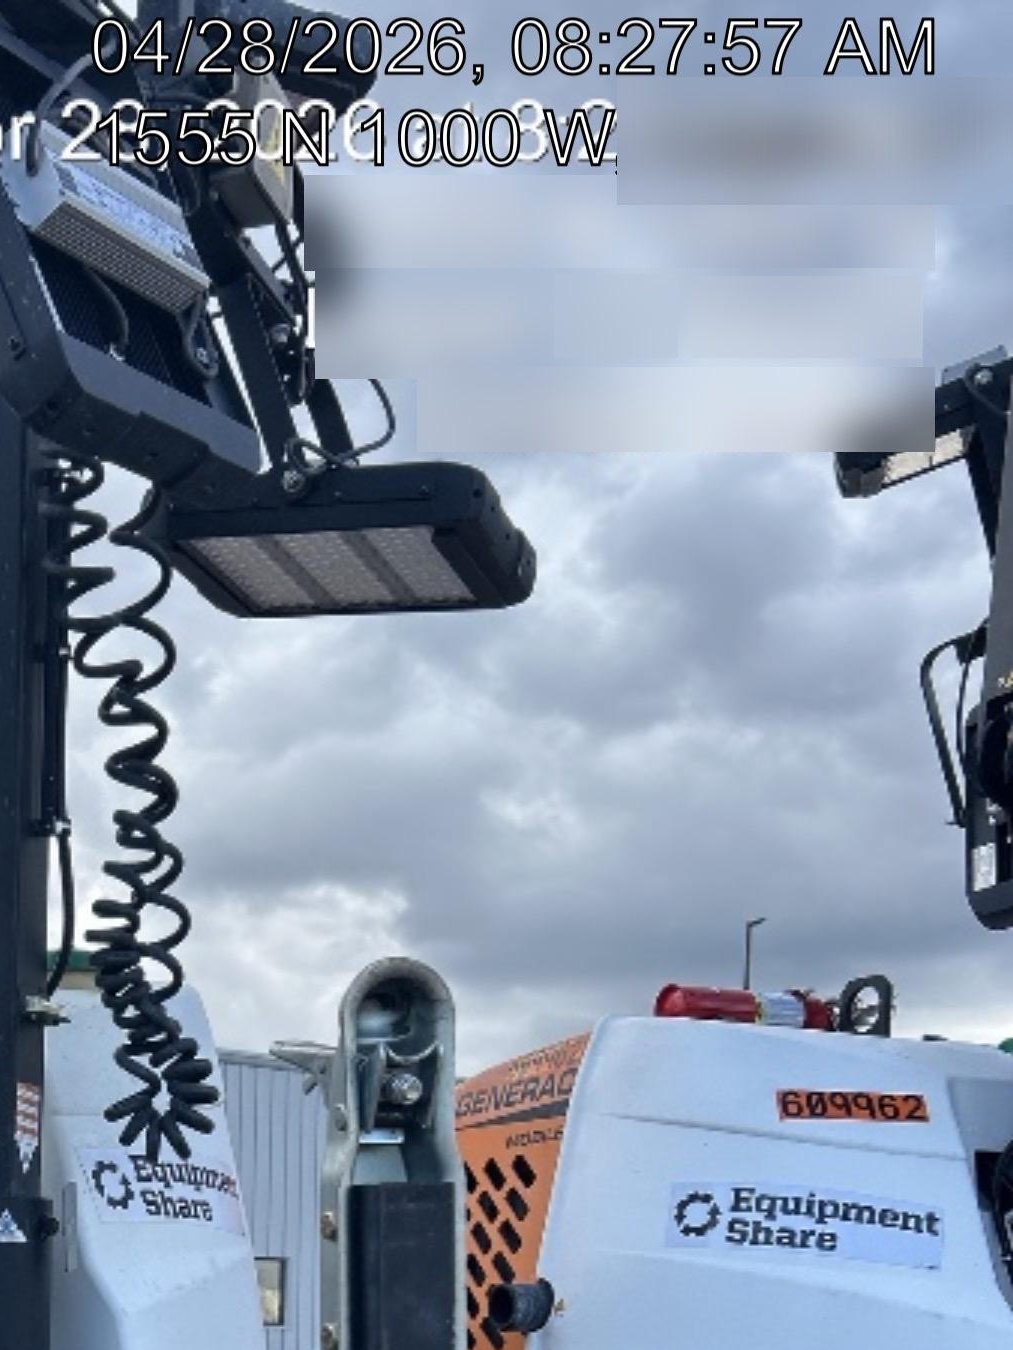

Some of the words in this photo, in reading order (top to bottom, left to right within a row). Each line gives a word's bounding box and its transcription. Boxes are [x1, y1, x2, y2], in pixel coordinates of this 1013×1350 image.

[780, 1090, 928, 1121] 609962
[140, 1189, 213, 1222] Share
[728, 1187, 941, 1237] Equipment
[724, 1217, 839, 1252] Share
